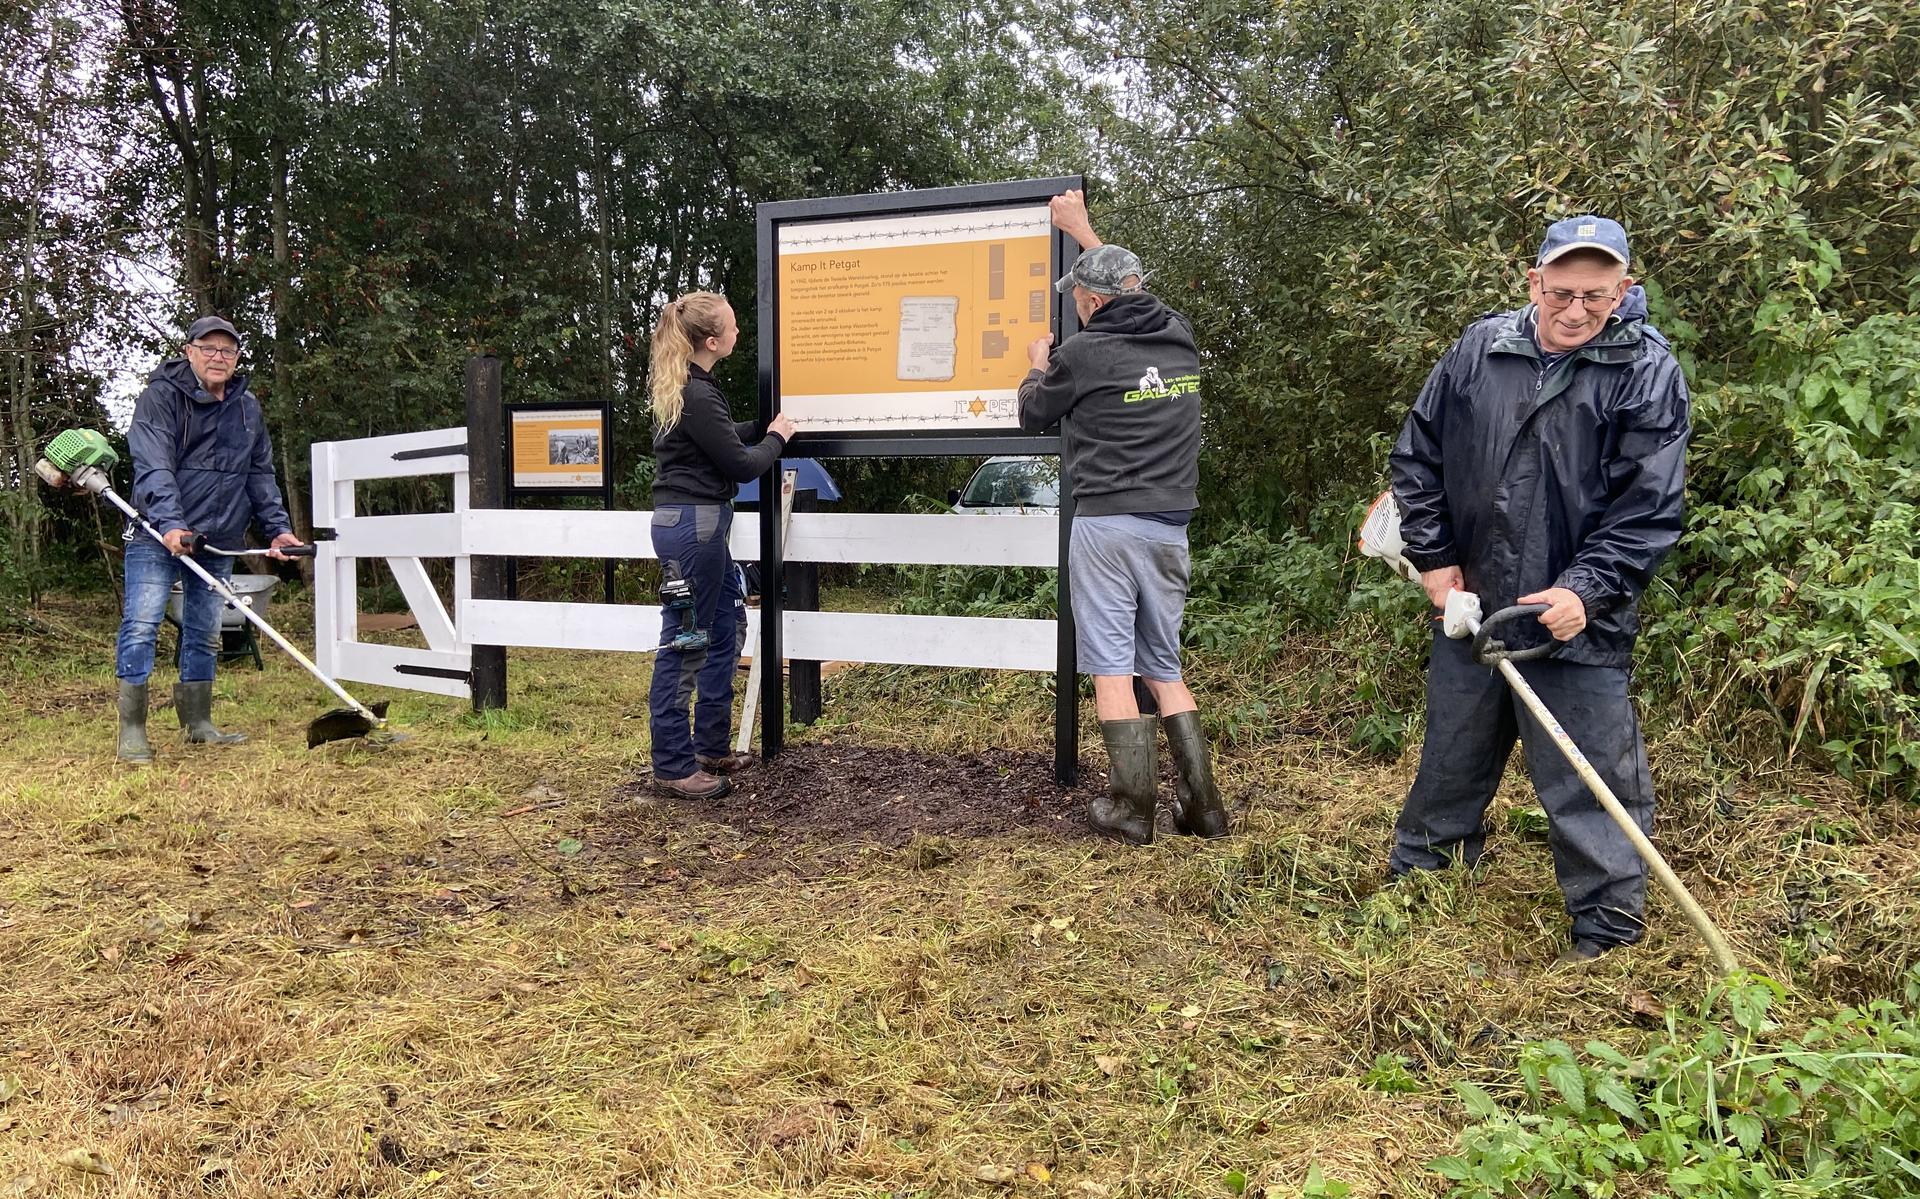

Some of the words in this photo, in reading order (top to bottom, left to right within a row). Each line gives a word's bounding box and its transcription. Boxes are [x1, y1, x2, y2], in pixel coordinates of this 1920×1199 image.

[790, 262, 817, 274] Kamp
[820, 261, 826, 270] It
[830, 260, 860, 271] Petgat
[954, 400, 968, 414] IT
[988, 398, 1018, 412] PET
